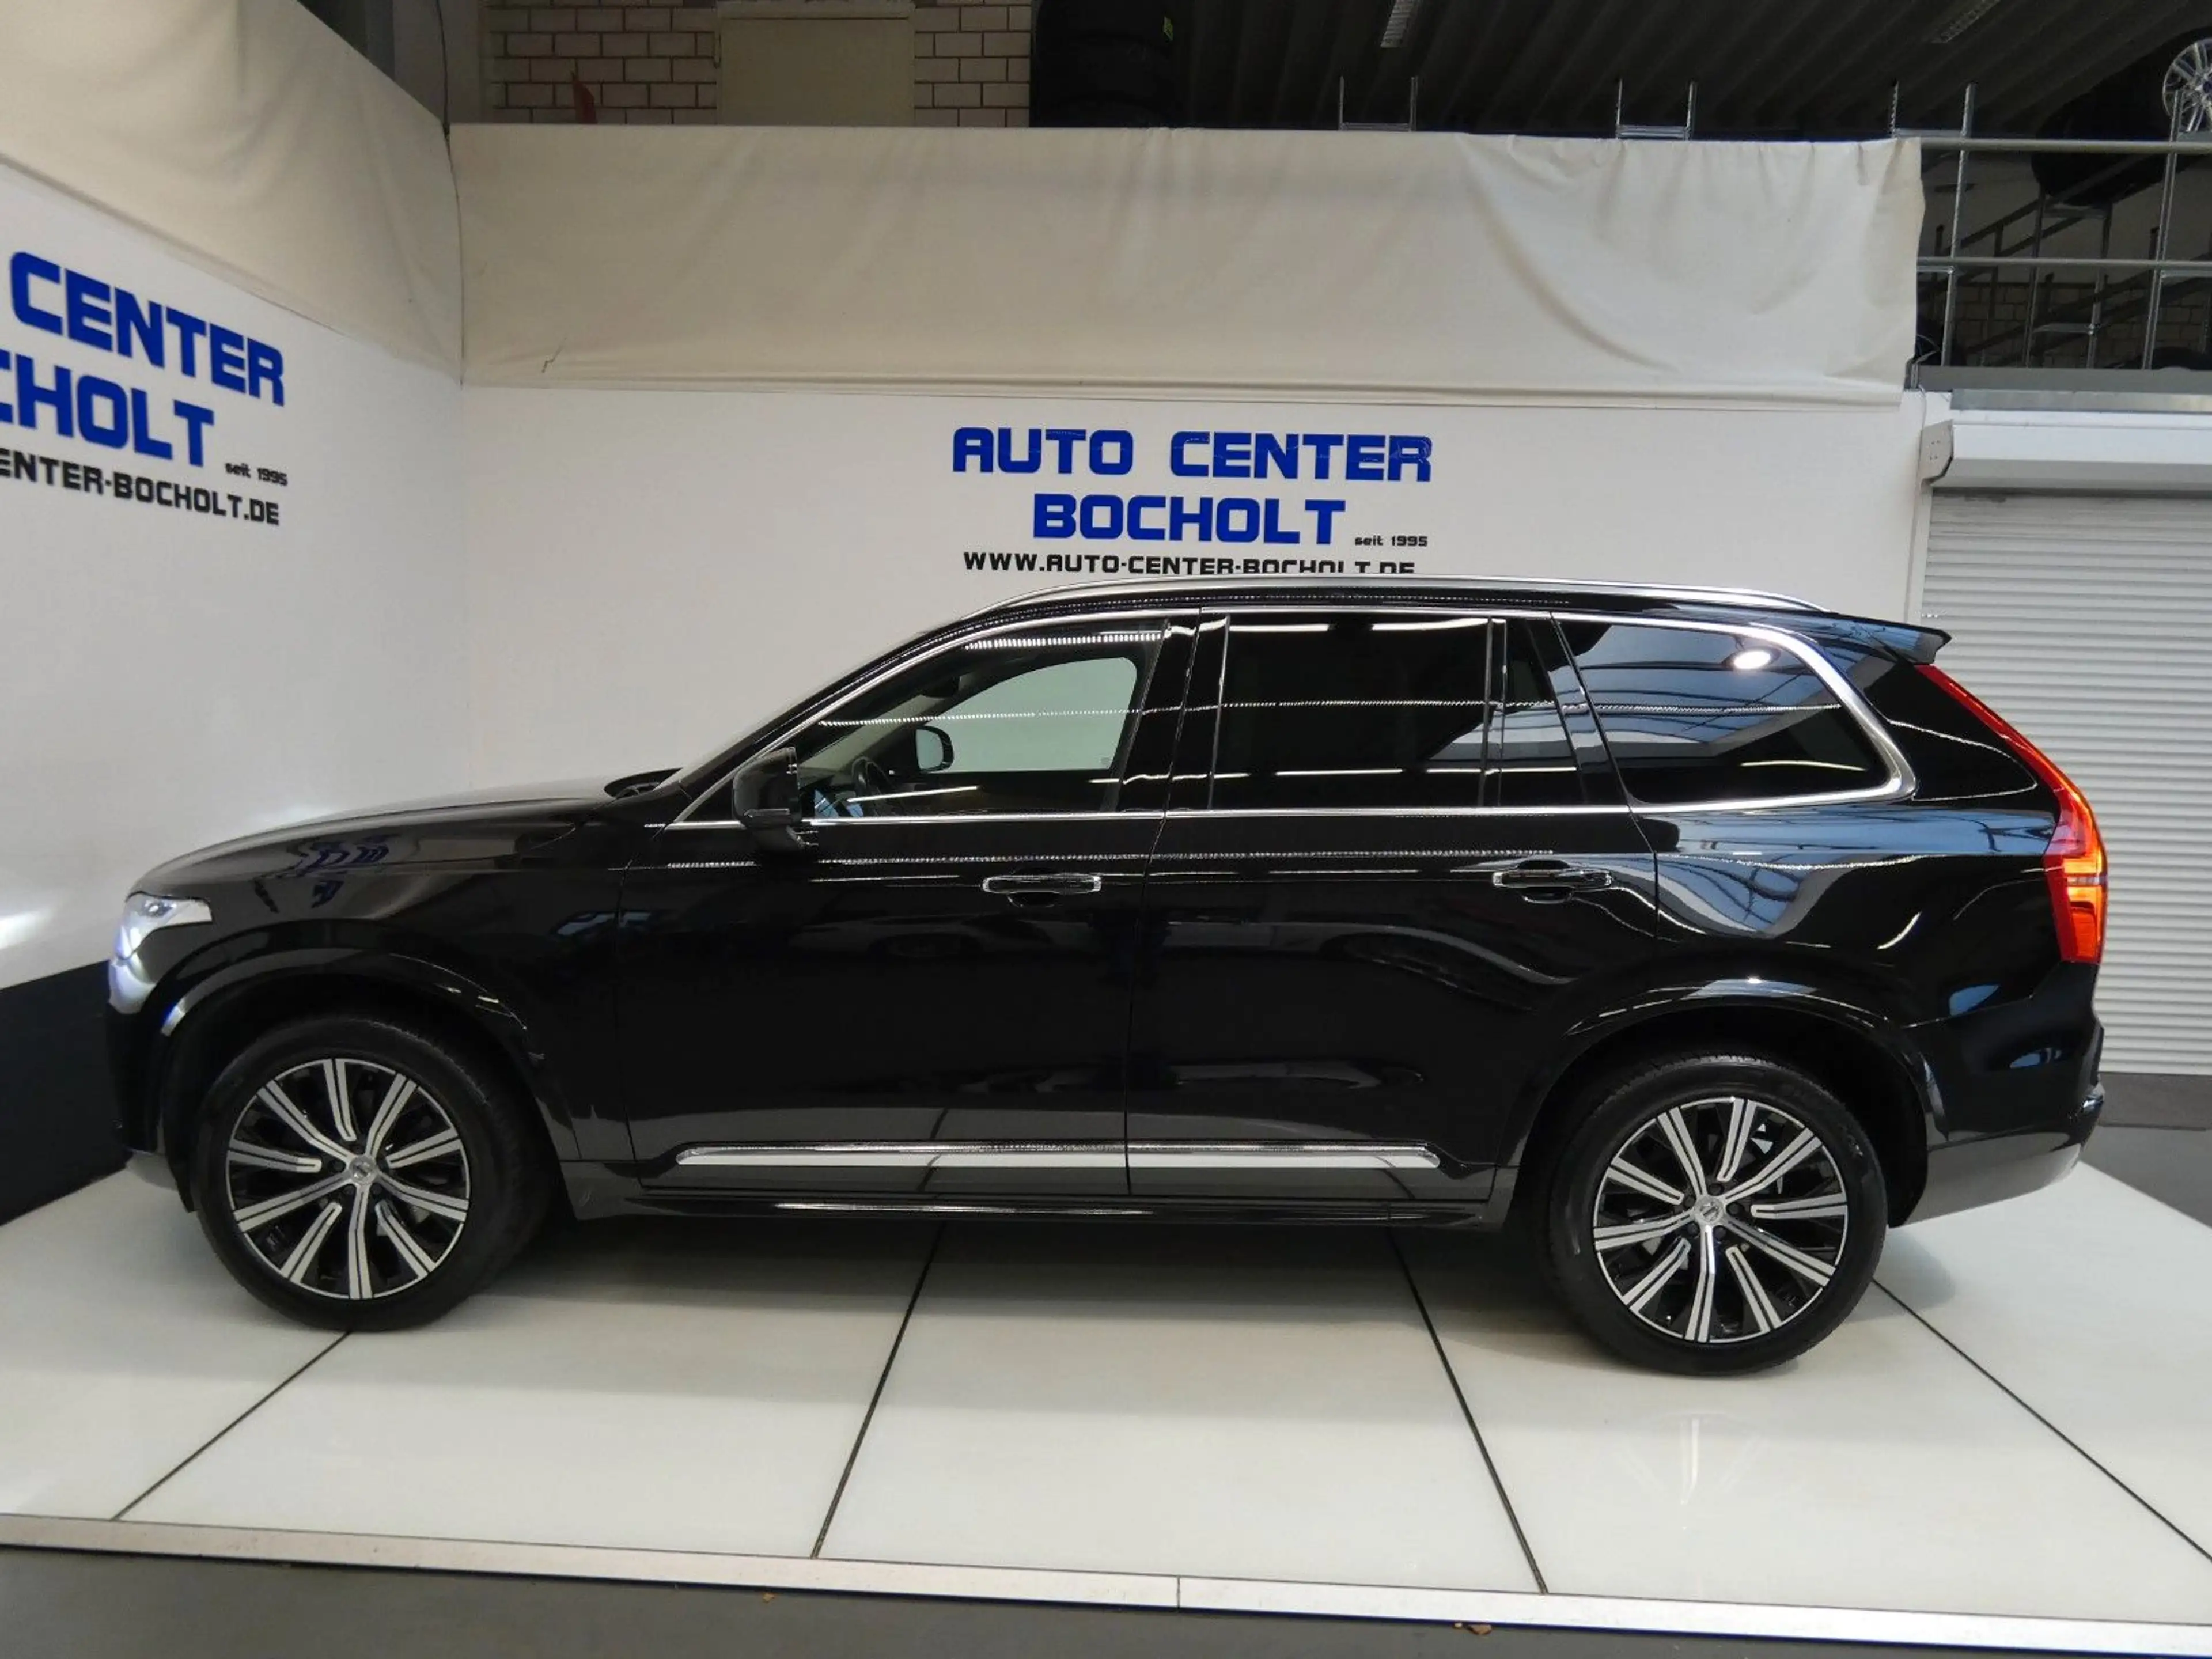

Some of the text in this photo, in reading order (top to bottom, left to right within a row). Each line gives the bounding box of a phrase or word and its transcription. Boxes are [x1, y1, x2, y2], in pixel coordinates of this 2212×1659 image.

[10, 252, 285, 407] CENTER
[0, 349, 214, 467] HOLT
[225, 463, 288, 486] seit 1995
[953, 427, 1432, 483] AUTO CENTER
[1033, 493, 1346, 545] BOCHOLT
[1354, 536, 1427, 547] seit 1995
[963, 552, 1415, 574] WWW.AUTO-CENTER-BOCHOTDE
